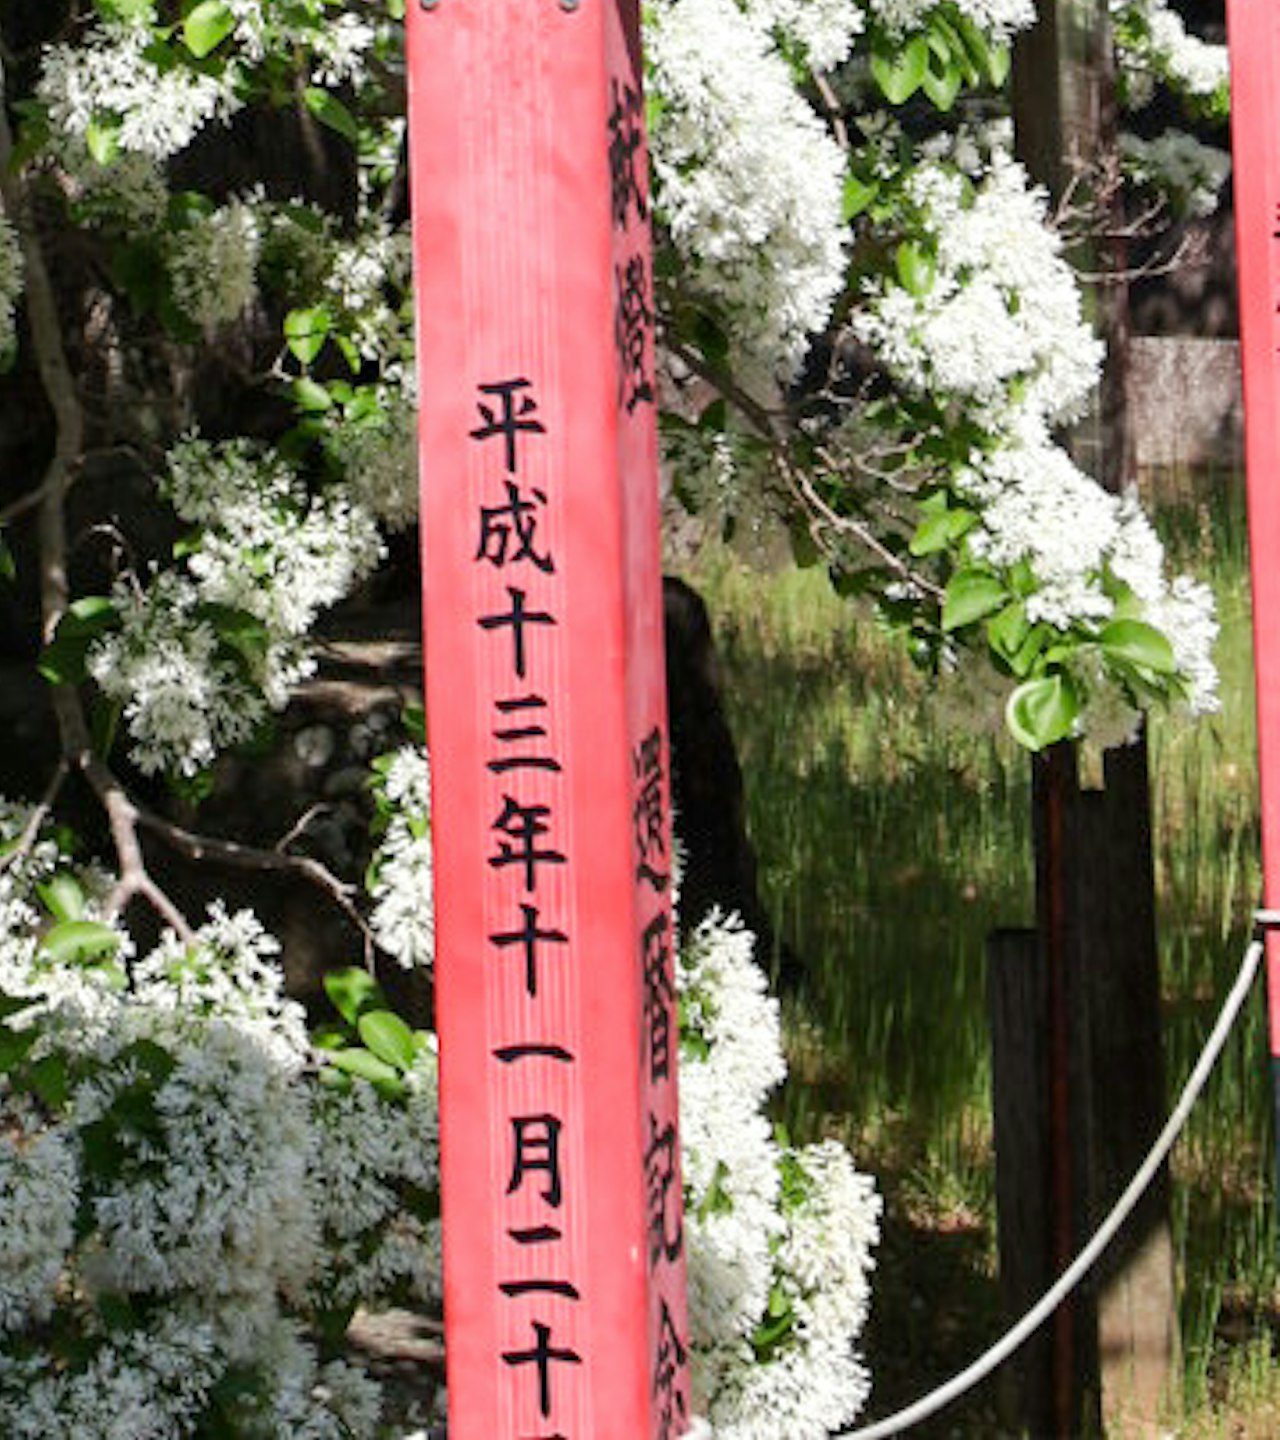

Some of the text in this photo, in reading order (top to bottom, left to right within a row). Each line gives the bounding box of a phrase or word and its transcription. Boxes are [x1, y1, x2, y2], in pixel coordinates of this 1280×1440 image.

[469, 377, 582, 1440] 平成十三年十一月二十
